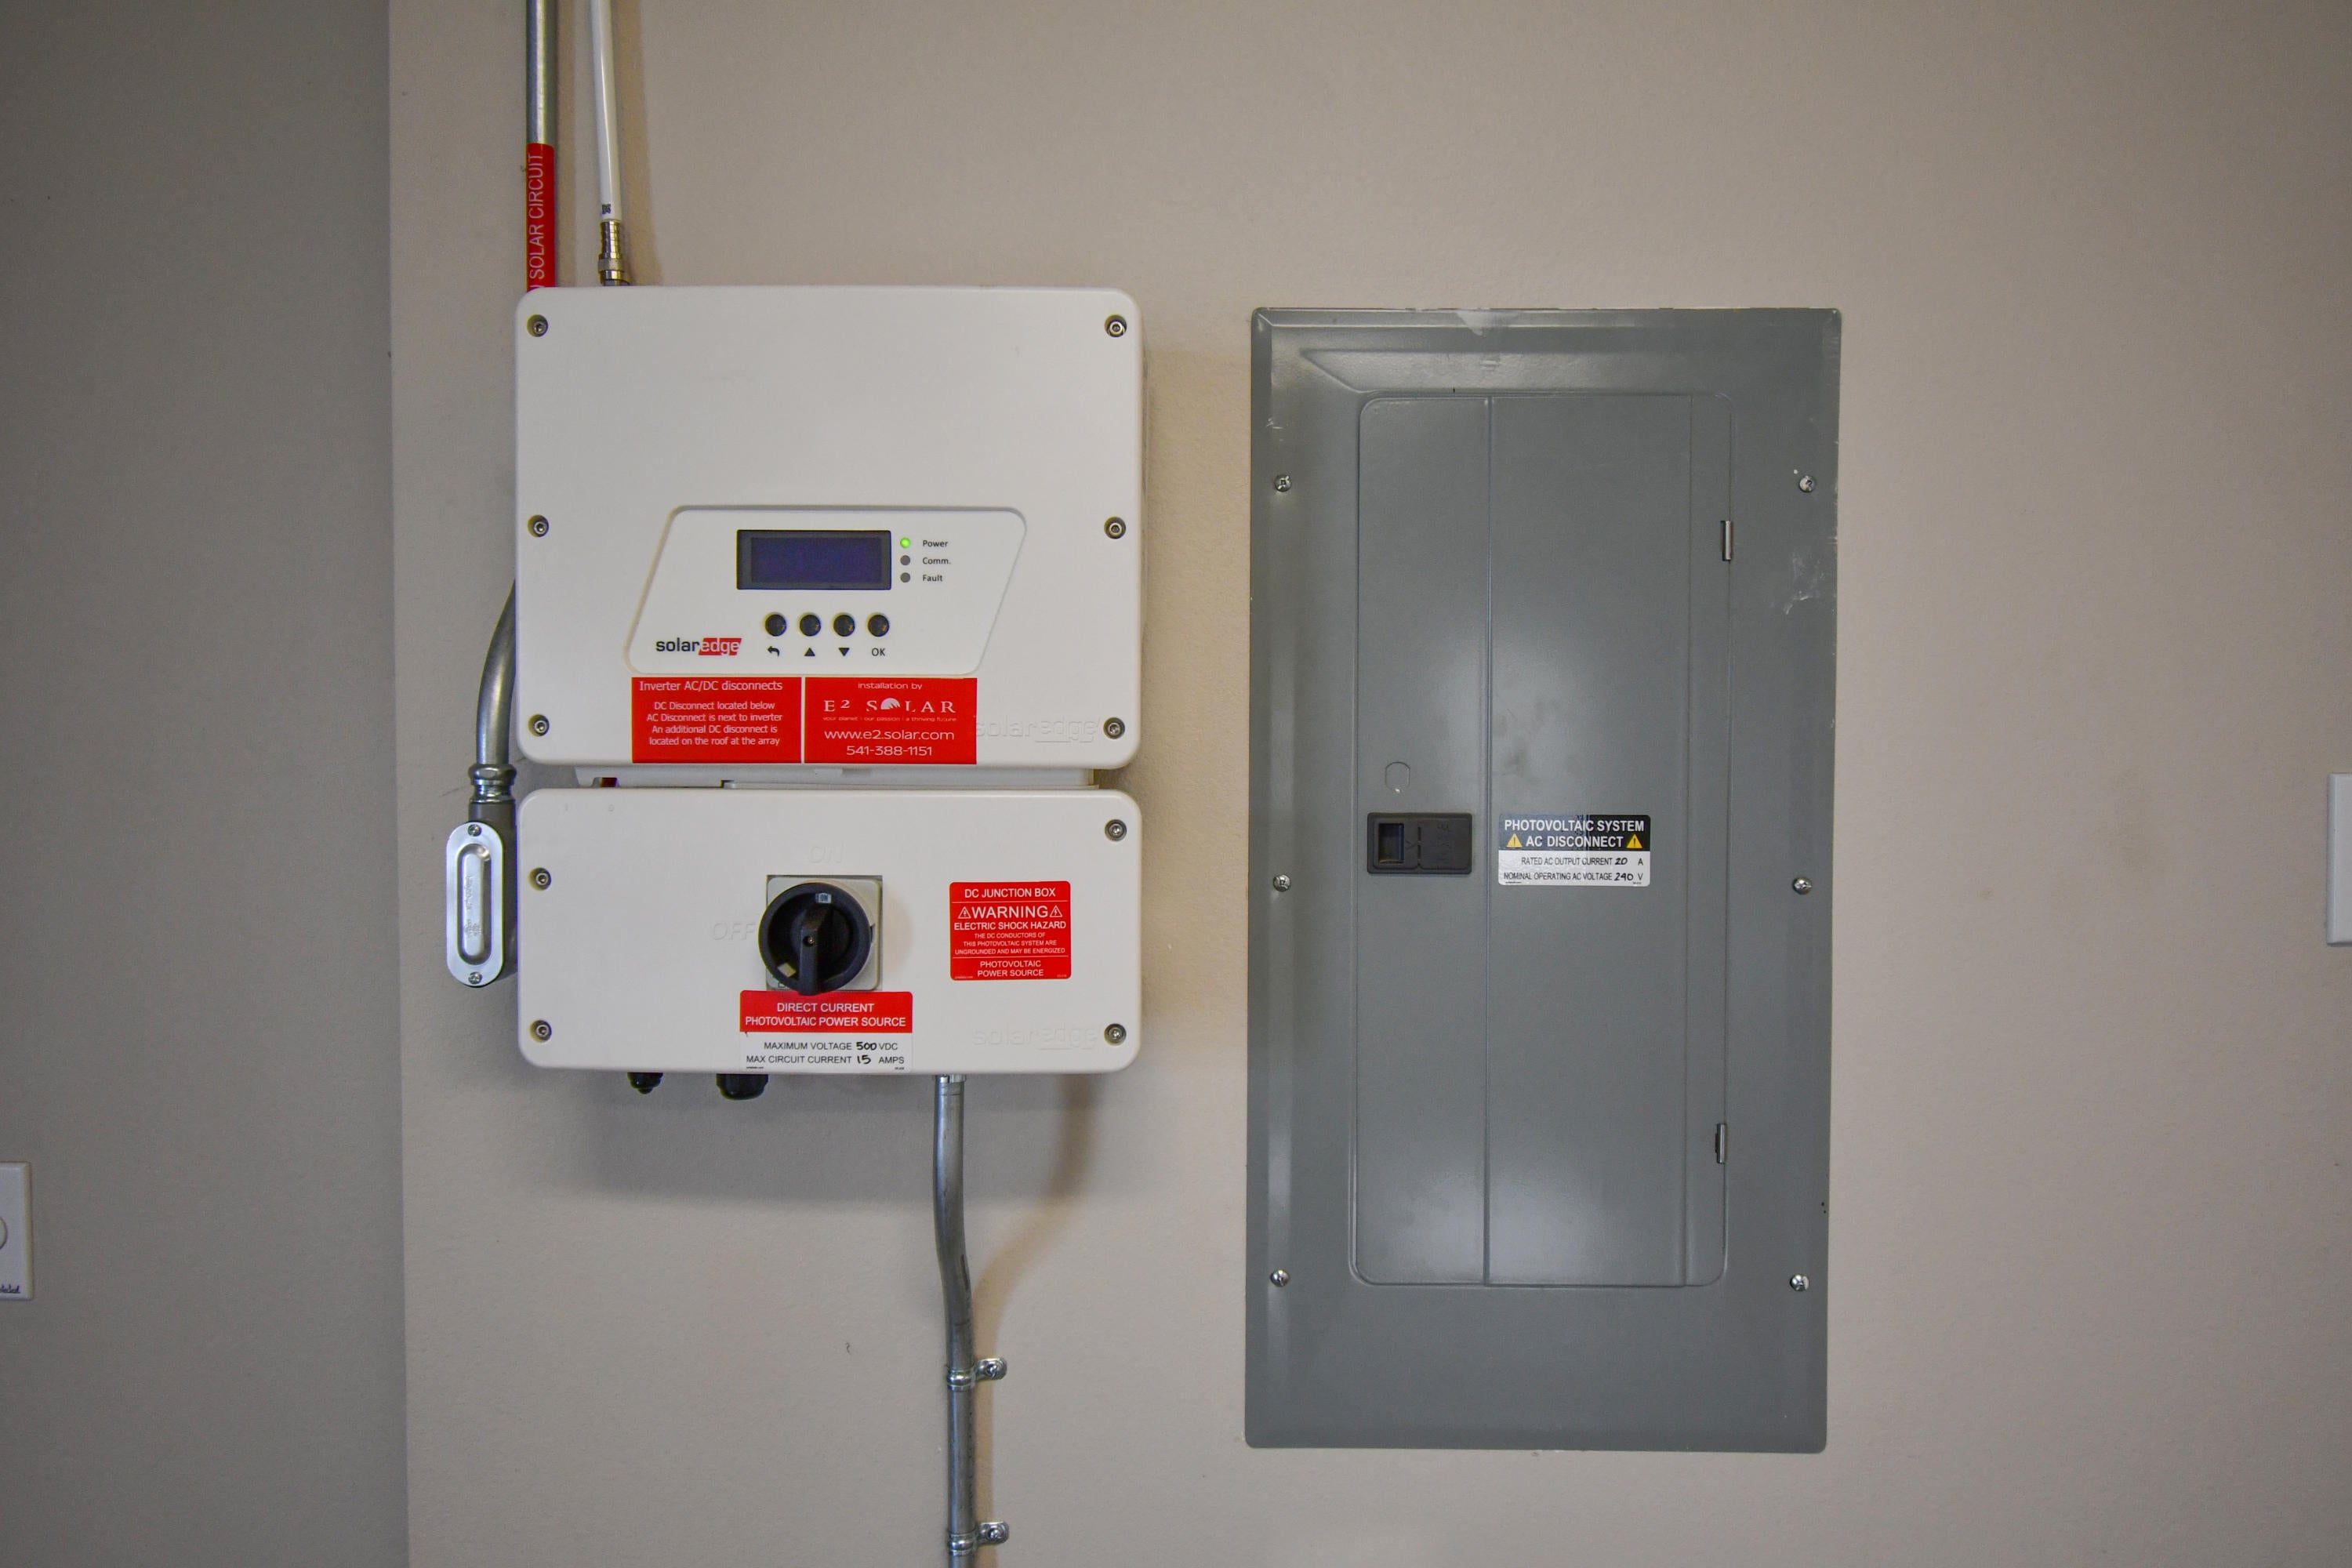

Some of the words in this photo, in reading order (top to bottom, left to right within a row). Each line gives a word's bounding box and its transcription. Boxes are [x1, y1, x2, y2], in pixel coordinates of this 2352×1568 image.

[528, 153, 545, 220] CIRCUIT
[528, 224, 545, 280] SOLAR
[922, 539, 949, 549] Power
[655, 637, 742, 656] solaredge
[871, 647, 886, 657] OK
[639, 681, 681, 691] Inverter
[684, 681, 718, 692] AC/DC
[721, 681, 782, 691] disconnects
[911, 682, 923, 691] by
[654, 702, 666, 710] DC
[670, 702, 714, 710] Disconnect
[717, 701, 747, 710] located
[750, 701, 775, 710] below
[647, 713, 659, 722] AC
[661, 713, 706, 722] Disconnect
[709, 713, 716, 722] is
[718, 713, 736, 722] next
[739, 713, 747, 722] to
[750, 713, 782, 722] inverter
[666, 725, 706, 734] additional
[709, 725, 720, 734] DC
[724, 725, 768, 734] disconnect
[771, 725, 778, 734] is
[824, 729, 955, 741] www.e2.solar.com
[649, 737, 679, 746] located
[695, 737, 709, 746] the
[711, 737, 728, 746] roof
[742, 737, 756, 746] the
[846, 746, 932, 757] 541-388-1151
[1504, 819, 1594, 832] PHOTOVOLTAIC
[1597, 820, 1644, 832] SYSTEM
[1526, 835, 1543, 847] AC
[1547, 836, 1624, 848] DISCONNECT
[1521, 857, 1542, 866] RATED
[1544, 857, 1553, 866] AC
[1554, 857, 1581, 866] OUTPUT
[1582, 857, 1613, 866] CURRENT
[1615, 857, 1628, 866] 20
[1504, 872, 1531, 880] NOMINAL
[1534, 872, 1570, 880] OPERATING
[1572, 872, 1581, 880] AC
[964, 889, 979, 898] DC
[982, 888, 1032, 898] JUNCTION
[1034, 887, 1056, 897] BOX
[971, 906, 1048, 919] WARNING
[711, 921, 757, 941] OFF
[954, 922, 996, 931] ELECTRIC
[998, 921, 1029, 930] SHOCK
[1030, 920, 1067, 929] HAZARD
[777, 1003, 817, 1013] DIRECT
[820, 1003, 875, 1013] CURRENT
[745, 1016, 817, 1026] PHOTOVOLTAIC
[818, 1017, 858, 1027] POWER
[861, 1017, 906, 1027] SOURCE
[764, 1042, 808, 1051] MAXIMUM
[810, 1042, 852, 1051] VOLTAGE
[856, 1041, 877, 1051] 500
[768, 1055, 805, 1064] CIRCUIT
[808, 1055, 852, 1064] CURRENT
[856, 1054, 871, 1065] 15
